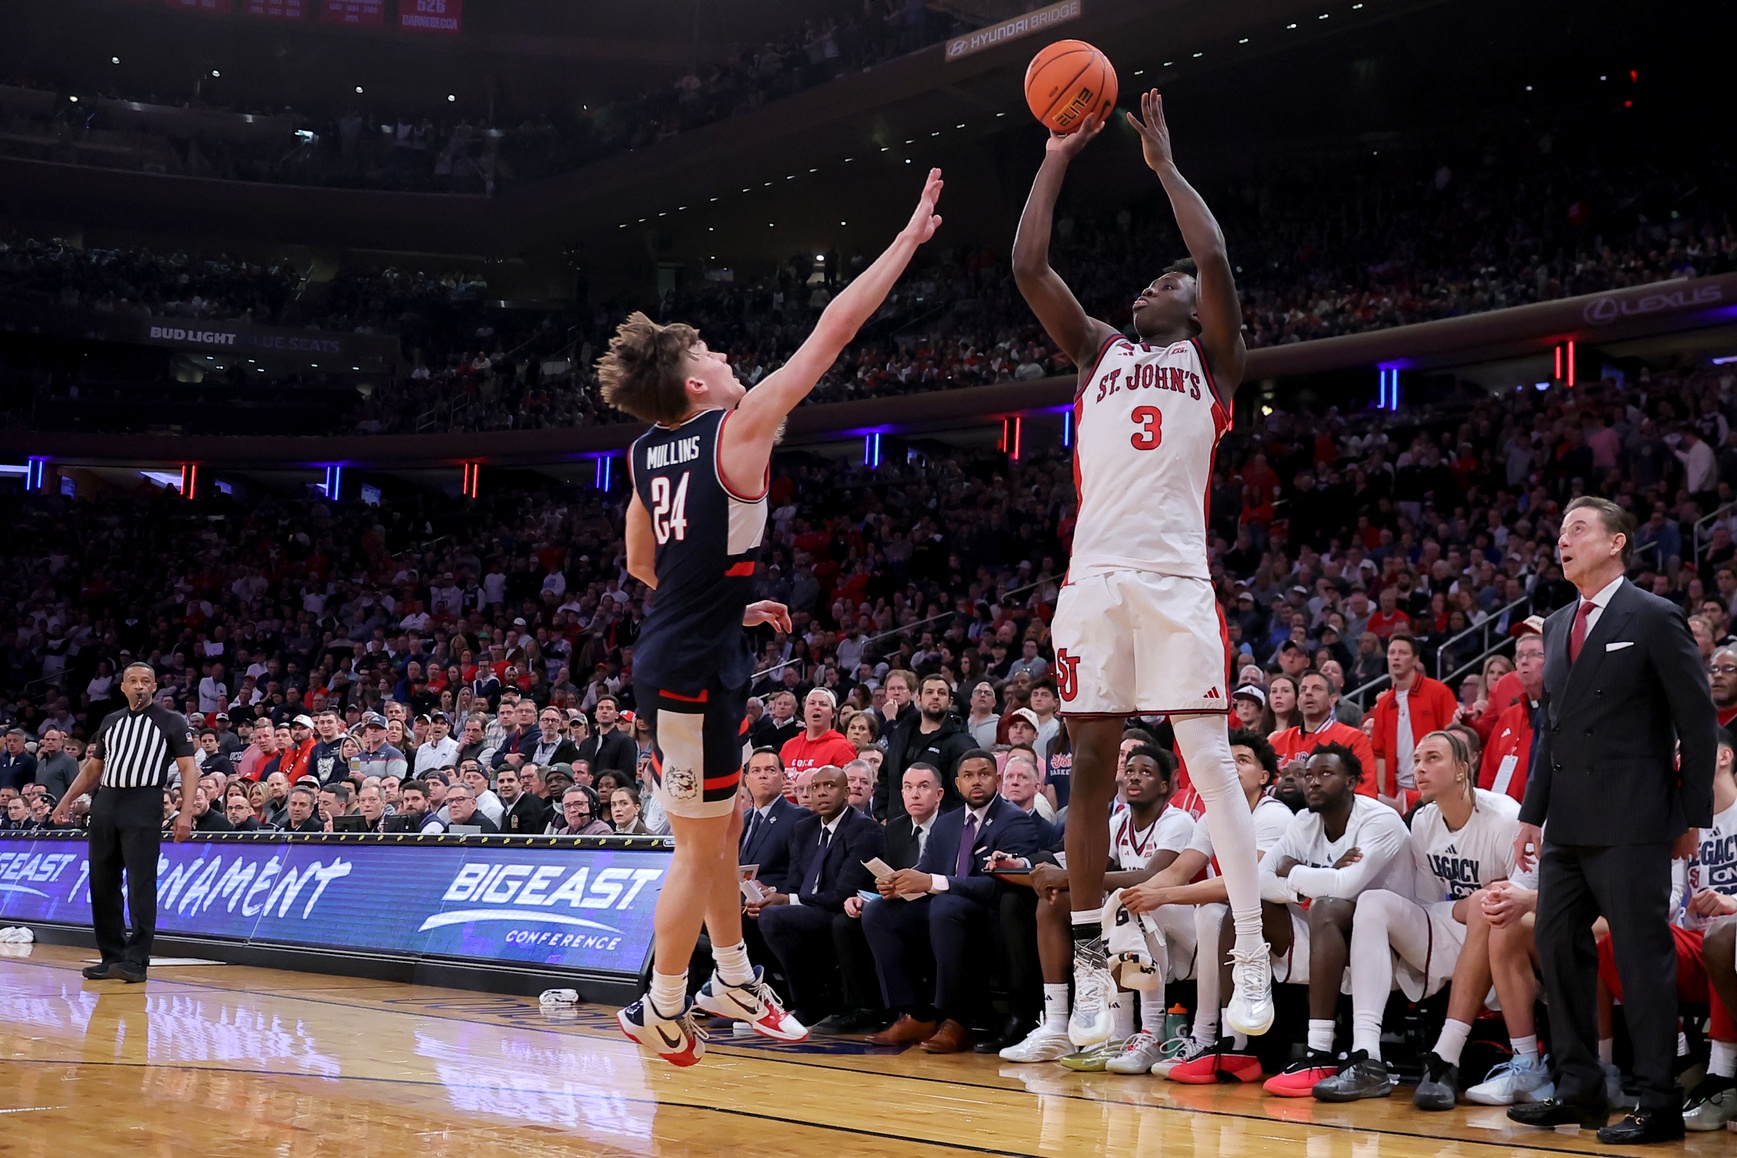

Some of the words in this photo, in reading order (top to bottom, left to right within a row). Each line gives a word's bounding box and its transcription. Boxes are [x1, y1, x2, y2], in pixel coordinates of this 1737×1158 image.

[971, 19, 1028, 48] HYUNDAI
[1031, 2, 1079, 28] BRIDGE
[1621, 286, 1722, 315] LEXUS
[150, 327, 186, 341] BUD
[187, 330, 236, 345] LIGHT
[289, 337, 340, 353] SEATS
[1096, 368, 1121, 404] ST.
[1126, 364, 1201, 401] JOHN'S
[1131, 405, 1164, 451] 3
[646, 435, 700, 470] MULLINS
[651, 470, 690, 546] 24
[68, 852, 353, 921] TNAMENT
[1426, 853, 1479, 883] LEGACY
[506, 930, 622, 951] CONFERENCE
